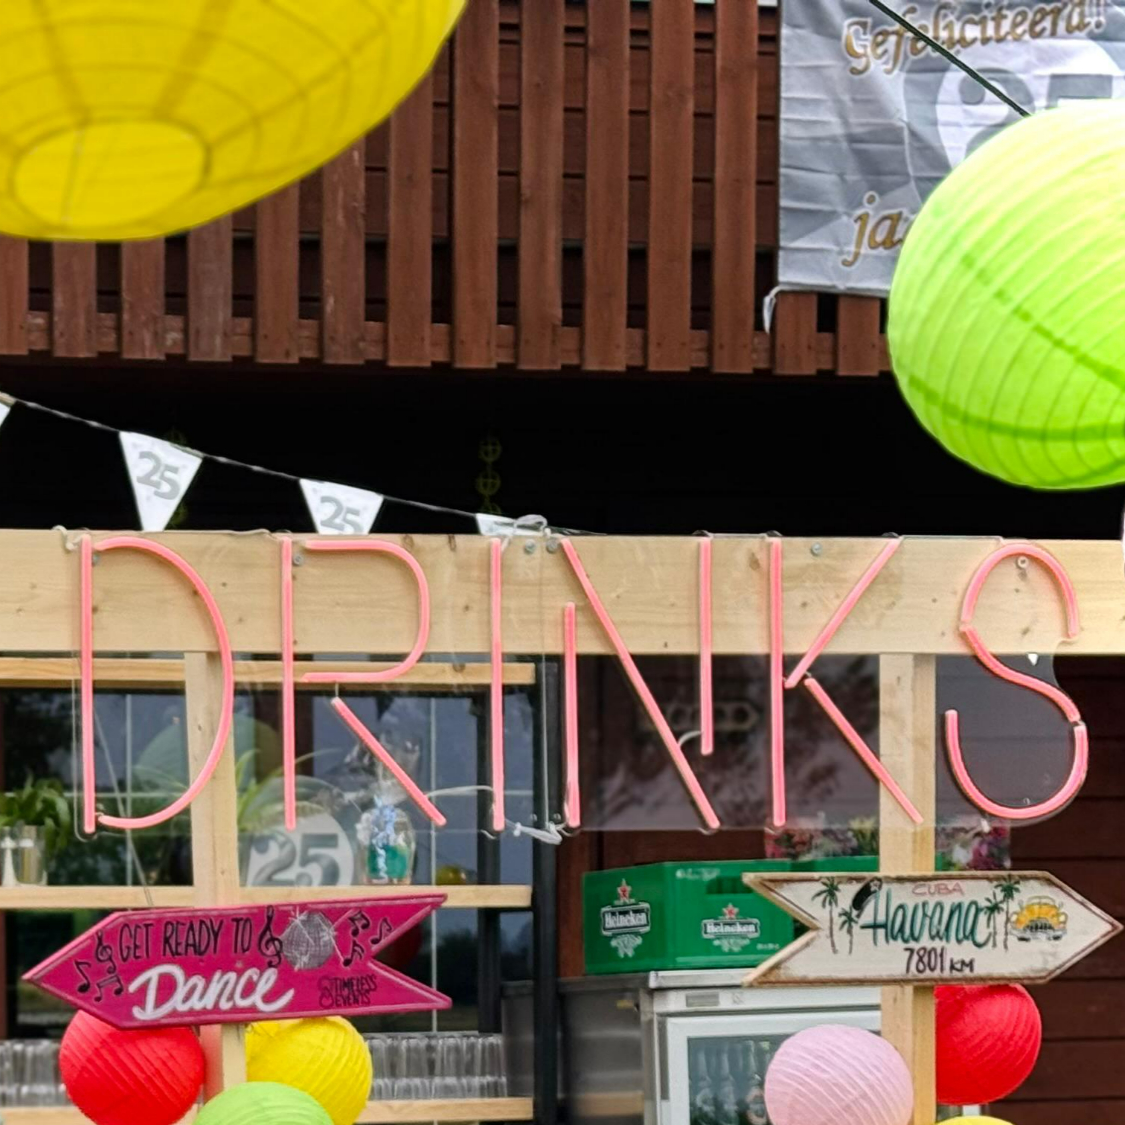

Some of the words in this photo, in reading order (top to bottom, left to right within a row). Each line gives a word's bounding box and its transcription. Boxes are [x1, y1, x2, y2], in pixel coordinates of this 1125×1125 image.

[136, 450, 181, 501] 25
[320, 495, 365, 535] 25
[81, 532, 1090, 833] DRINKS
[252, 832, 341, 887] 25
[911, 881, 965, 898] CUBA
[118, 922, 154, 963] GET
[162, 918, 224, 958] READY
[231, 916, 253, 954] TO
[604, 909, 649, 930] Heineken
[705, 921, 757, 935] Heineken
[859, 886, 993, 949] Havana
[903, 945, 945, 975] 7801
[127, 962, 295, 1021] Dance
